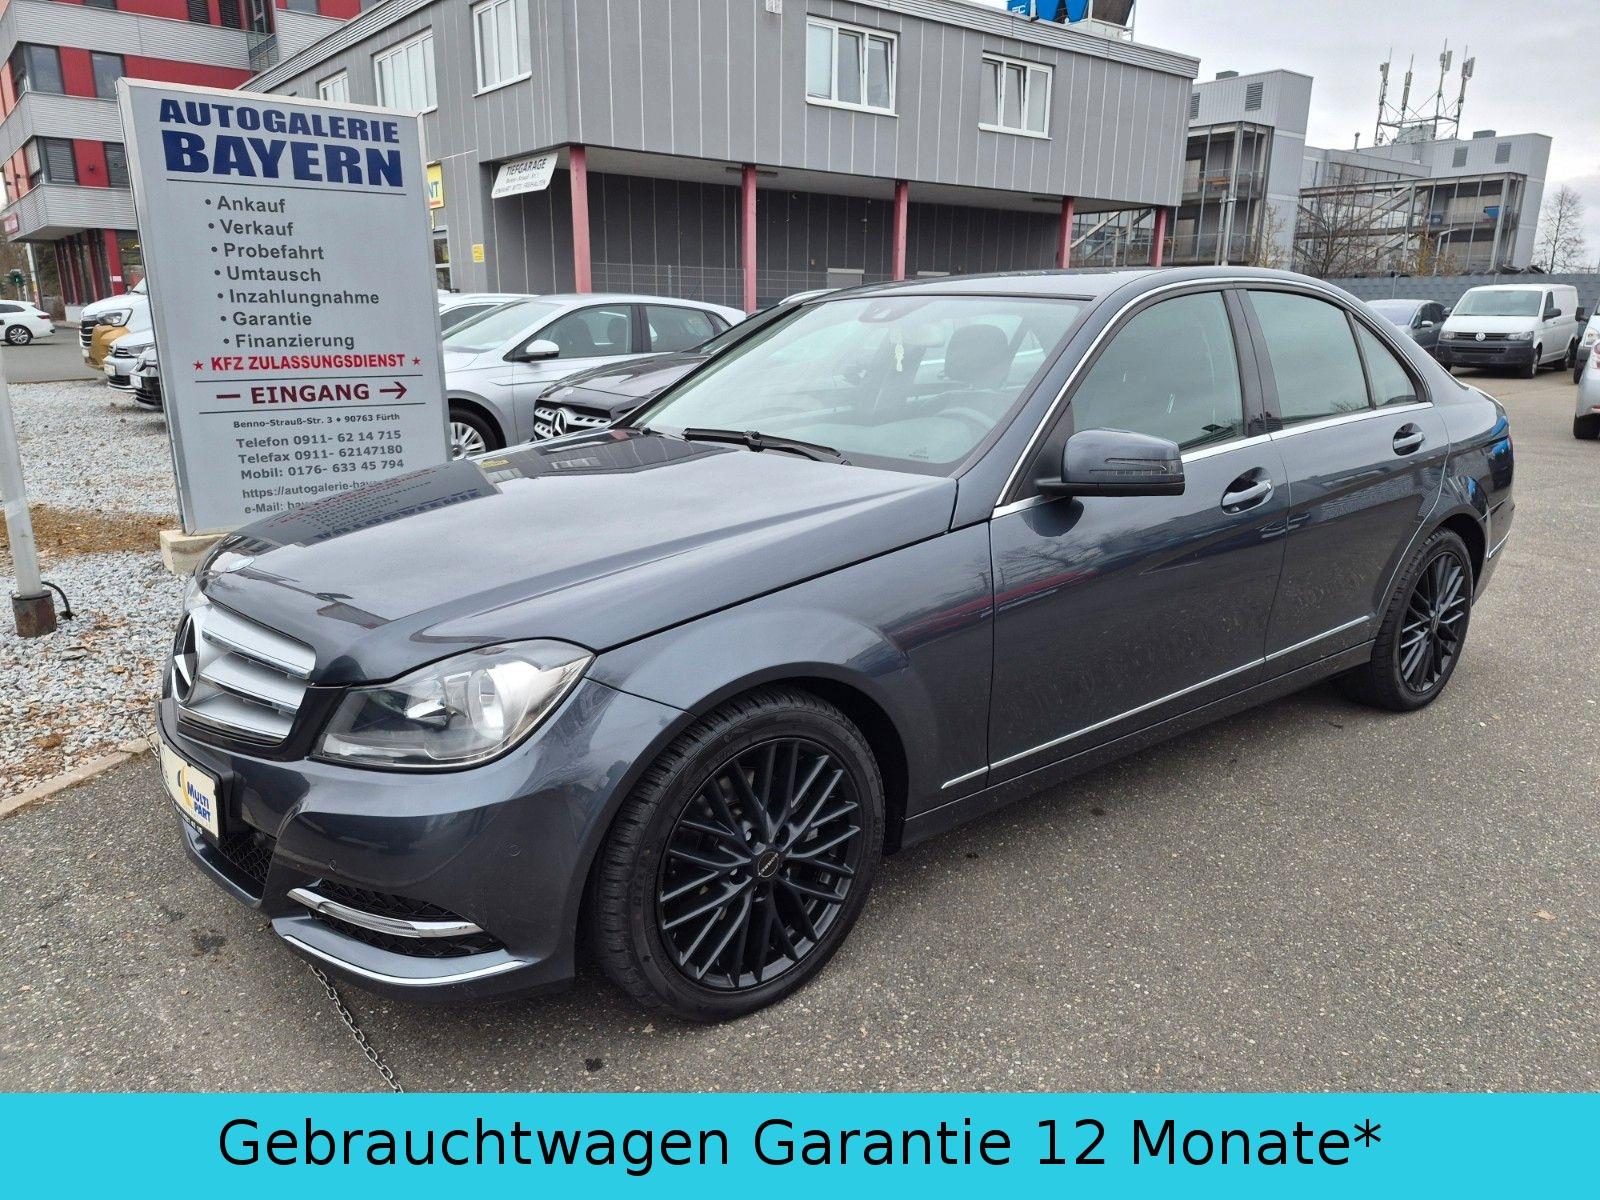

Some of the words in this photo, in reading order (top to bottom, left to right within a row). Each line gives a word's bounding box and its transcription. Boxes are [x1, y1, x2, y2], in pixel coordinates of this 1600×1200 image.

[159, 98, 399, 144] AUTOGALERIE
[161, 129, 404, 187] BAYERN
[216, 195, 286, 214] Ankauf
[219, 218, 294, 237] Verkauf
[223, 242, 325, 260] Probefahrt
[226, 265, 321, 282] Umtausch
[229, 288, 380, 307] Inzahlungnahme
[232, 311, 312, 326] Garantie
[235, 333, 355, 351] Finanzierung
[210, 356, 245, 371] KFZ
[247, 353, 406, 370] ZULASSUNGSDIENST
[250, 383, 370, 405] EINGANG
[233, 415, 325, 429] Benno-Strauß-Str.
[327, 416, 333, 424] 3
[344, 414, 374, 423] 90763
[376, 412, 402, 423] Fürth
[235, 436, 289, 449] Telefon
[293, 434, 334, 446] 0911-
[337, 432, 354, 443] 62
[358, 431, 374, 442] 14
[377, 429, 402, 441] 715
[237, 452, 291, 464] Telefax
[294, 449, 334, 461] 0911-
[338, 444, 403, 458] 62147180
[240, 467, 283, 480] Mobil:
[287, 464, 328, 477] 0176-
[332, 462, 357, 473] 633
[360, 460, 377, 471] 45
[380, 459, 405, 470] 794
[244, 501, 284, 515] e-Mail:
[194, 802, 211, 822] PART
